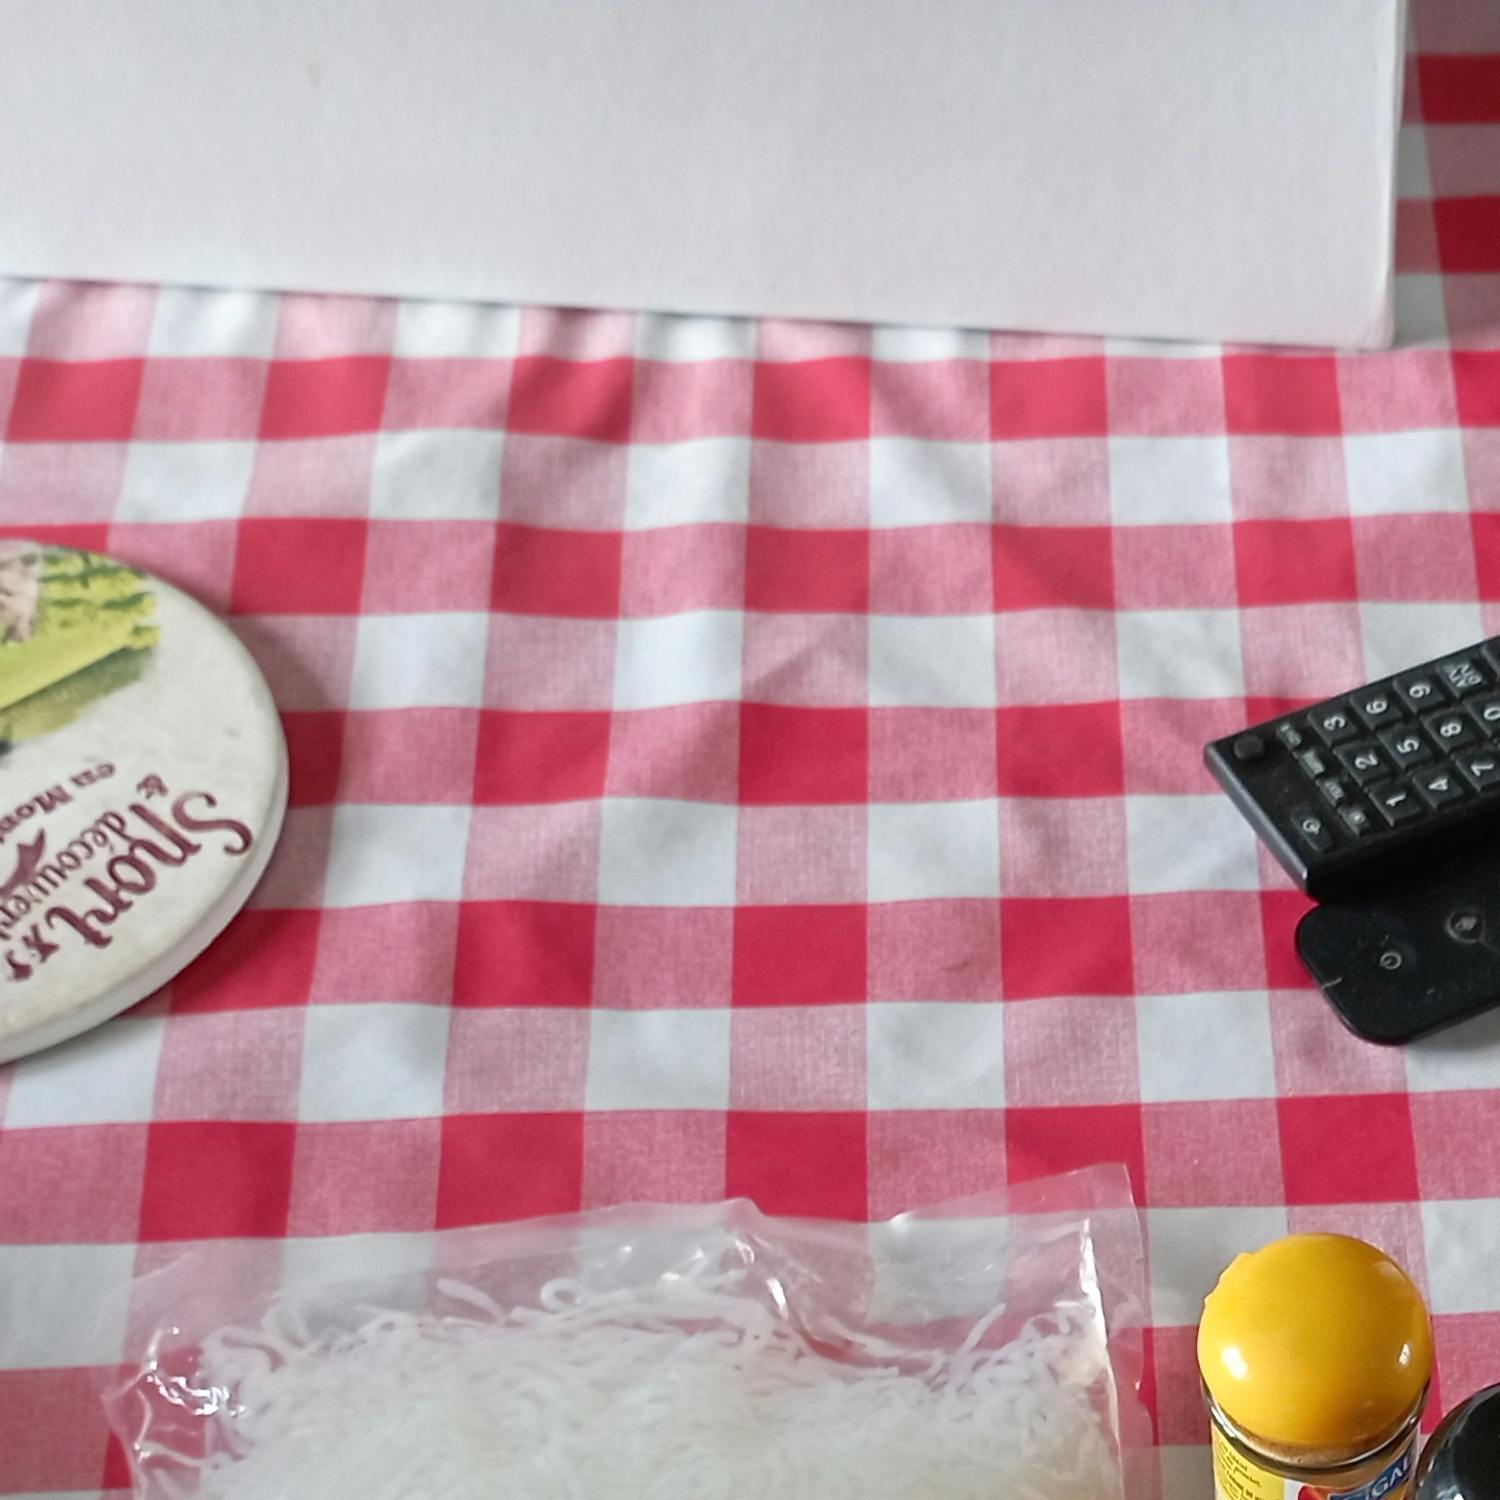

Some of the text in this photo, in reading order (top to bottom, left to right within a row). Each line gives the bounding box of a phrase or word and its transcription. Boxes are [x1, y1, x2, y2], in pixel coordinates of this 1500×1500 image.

[1409, 682, 1431, 698] 9
[1365, 699, 1388, 714] 6
[1323, 715, 1346, 730] 3
[1440, 722, 1462, 737] 8
[1396, 738, 1419, 754] 5
[1354, 753, 1379, 769] 2
[1470, 762, 1494, 776] 7
[1428, 778, 1448, 792] 4
[1386, 791, 1407, 807] 1
[0, 784, 74, 844] Mon
[0, 810, 128, 940] découver
[45, 791, 254, 949] Sport
